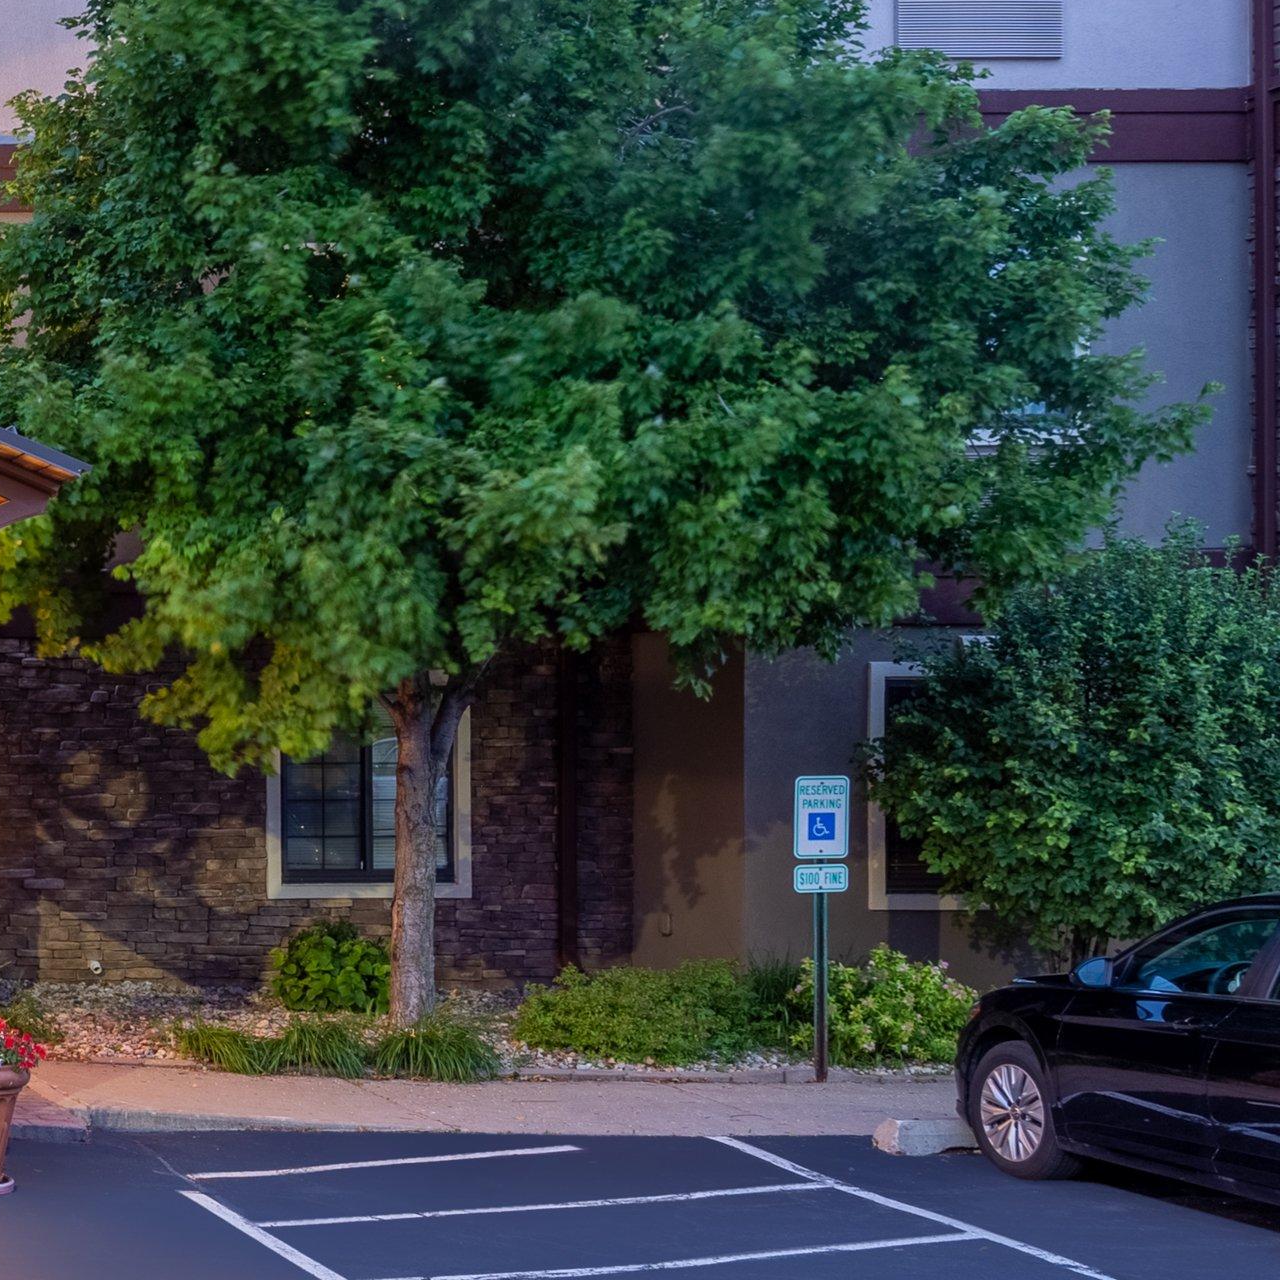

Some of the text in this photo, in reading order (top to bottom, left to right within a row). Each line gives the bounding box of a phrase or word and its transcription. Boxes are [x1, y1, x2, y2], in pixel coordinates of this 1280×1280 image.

[800, 785, 845, 796] RESERVED
[802, 799, 842, 809] PARKING
[800, 872, 842, 885] $100 FINE
